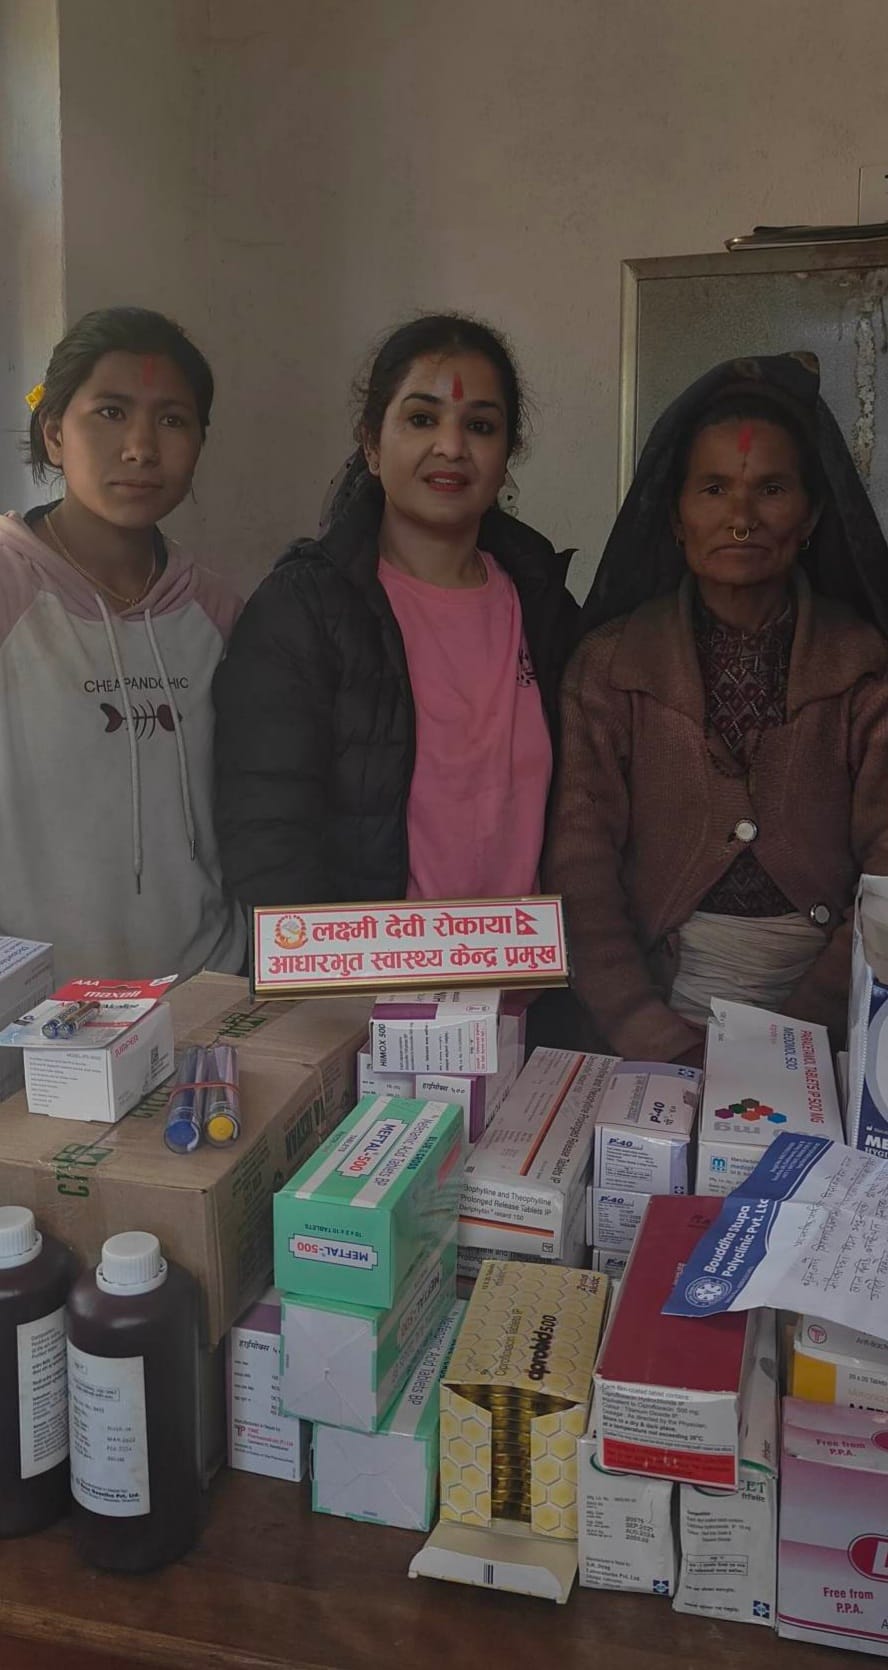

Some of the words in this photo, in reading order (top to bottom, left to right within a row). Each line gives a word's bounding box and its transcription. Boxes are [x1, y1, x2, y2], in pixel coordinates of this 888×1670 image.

[311, 915, 379, 942] लक्ष्मी
[385, 913, 426, 938] देवी
[433, 912, 513, 937] रोकाया
[268, 951, 363, 976] आधारभुत
[370, 948, 443, 971] स्वास्थ्य
[450, 943, 498, 967] केन्द्र
[505, 945, 557, 969] प्रमुख
[83, 990, 143, 998] maxell
[378, 1023, 386, 1038] 500
[377, 1040, 387, 1067] HIMOX
[785, 1057, 798, 1071] 500
[497, 1191, 510, 1199] and
[704, 1232, 735, 1274] Bouddha
[731, 1205, 751, 1233] Stupa
[721, 1234, 755, 1278] Polyclinic
[747, 1215, 765, 1234] Pvt.
[613, 1424, 647, 1435] temperature
[658, 1431, 688, 1441] exceeding
[815, 1438, 839, 1447] Free
[828, 1448, 857, 1457] P.P.A.
[823, 1587, 847, 1598] Free
[849, 1588, 874, 1600] from
[836, 1602, 864, 1615] P.P.A.
